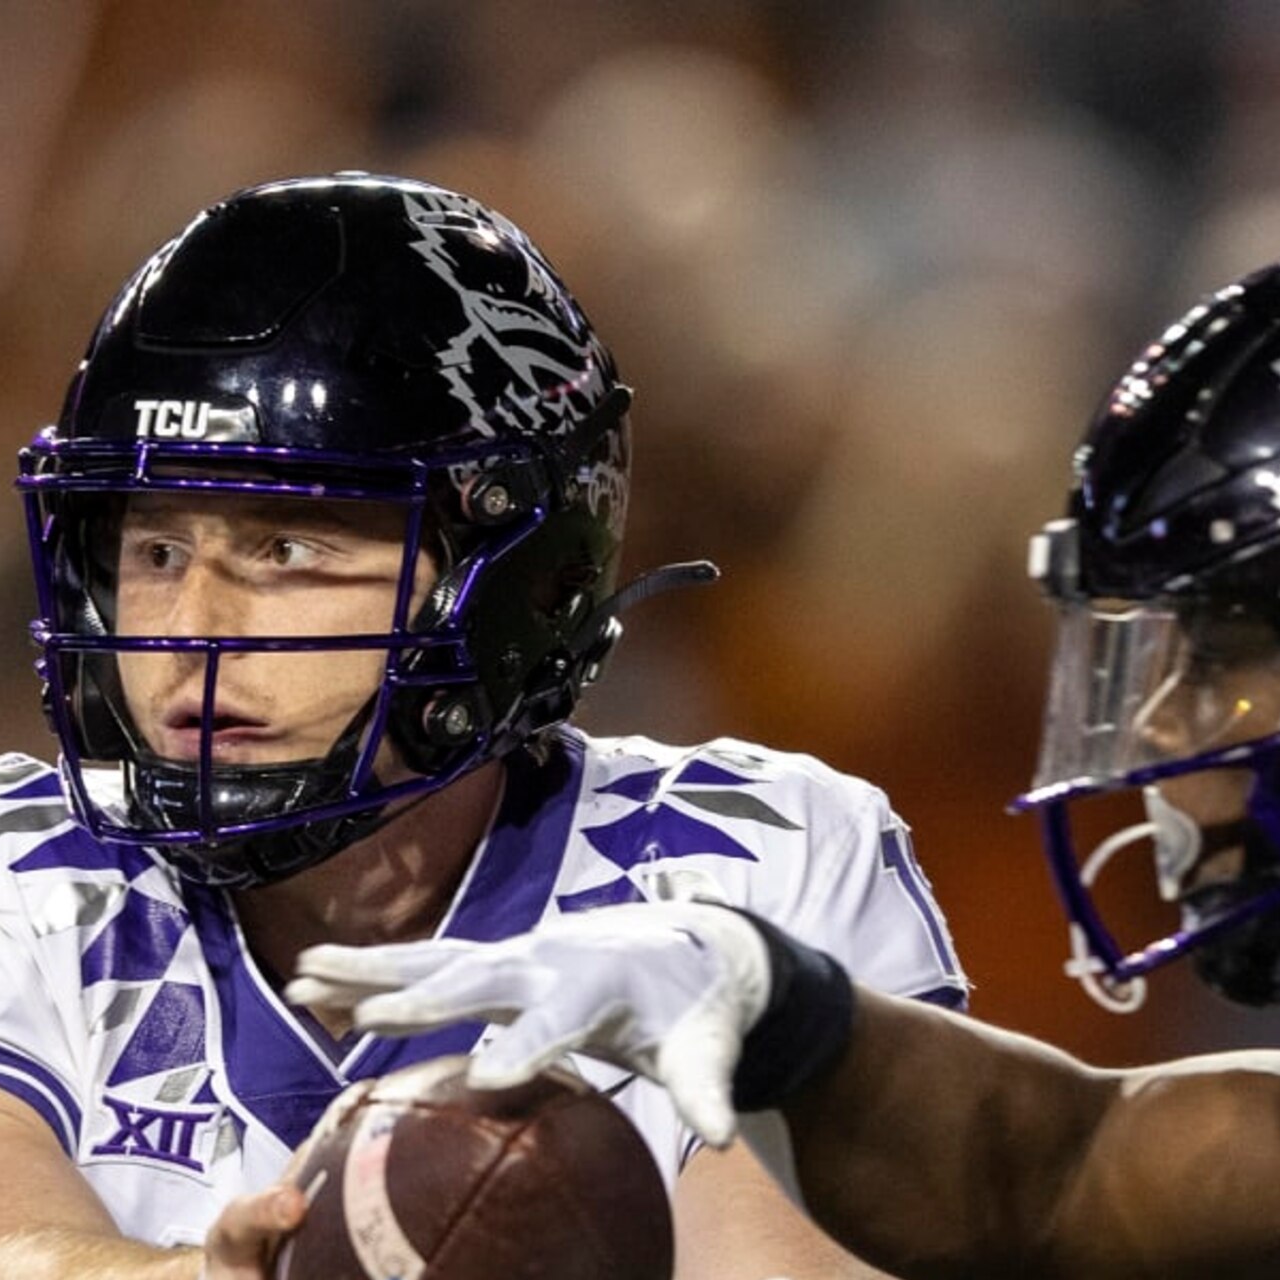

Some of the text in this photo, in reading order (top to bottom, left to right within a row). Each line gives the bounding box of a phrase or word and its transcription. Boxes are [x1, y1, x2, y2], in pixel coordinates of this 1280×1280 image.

[134, 400, 211, 438] TCU
[880, 826, 959, 977] 1
[91, 1094, 217, 1173] XII
